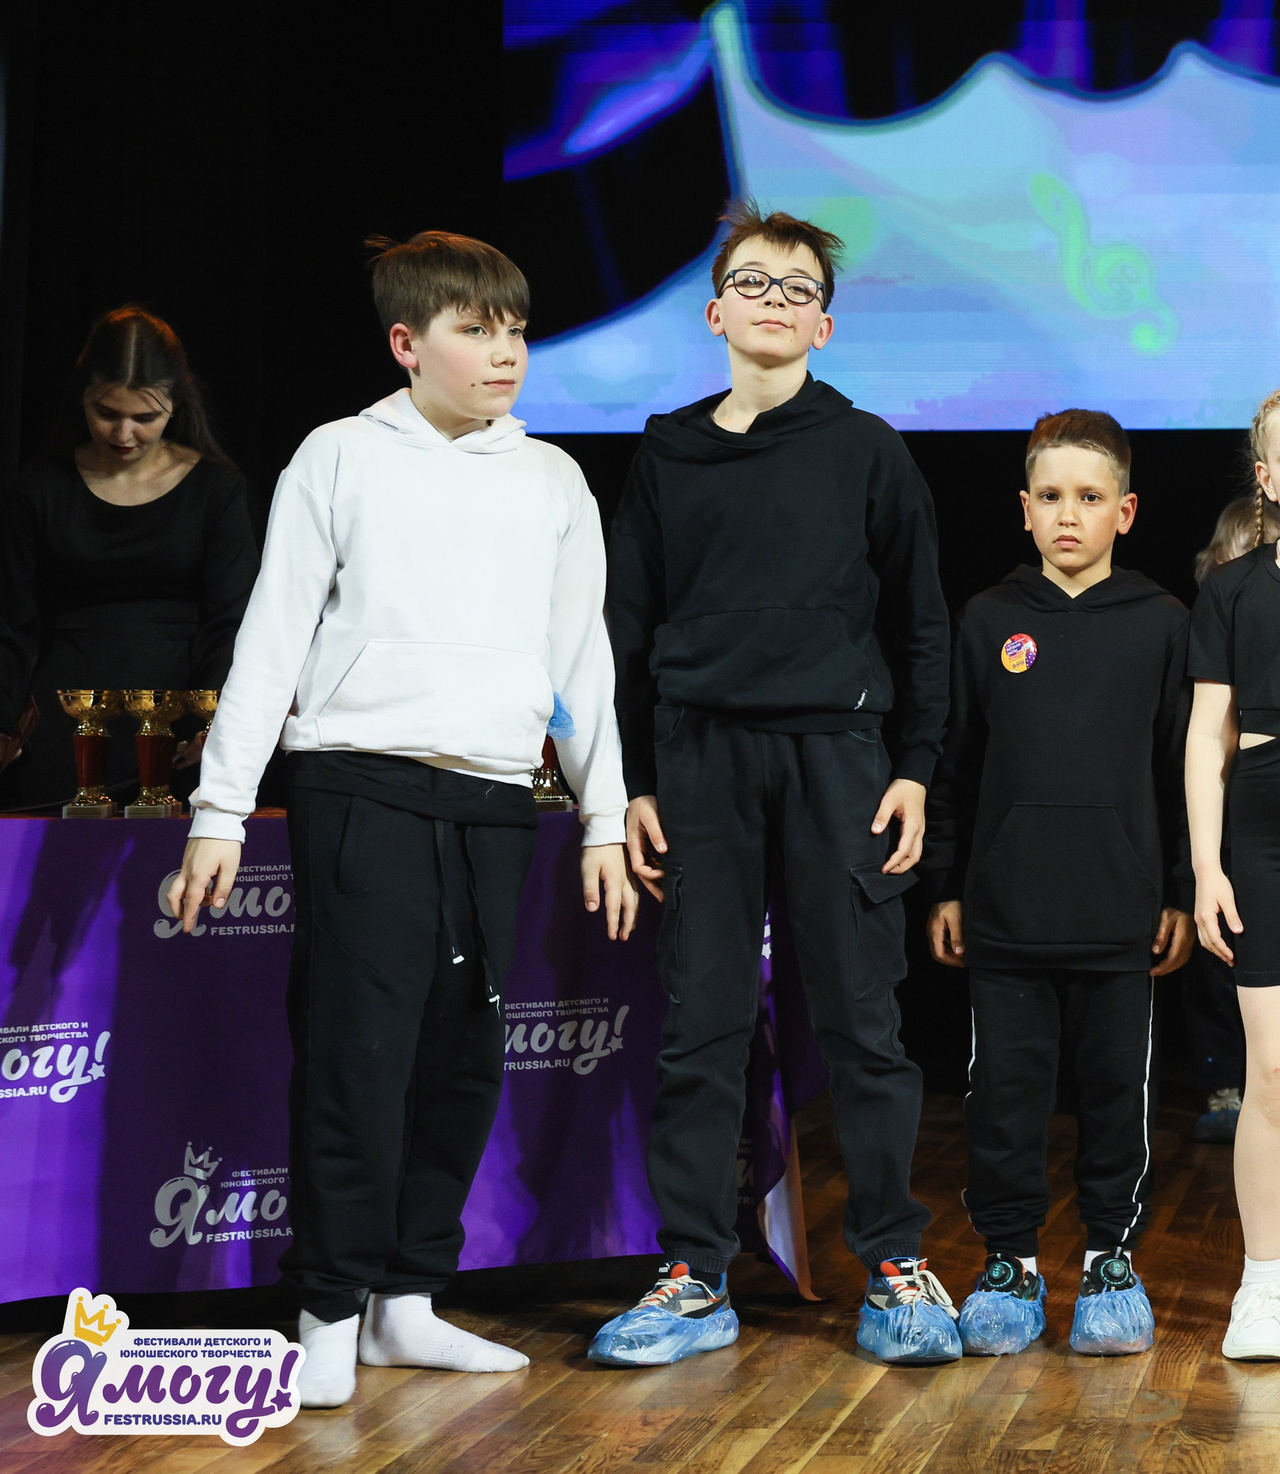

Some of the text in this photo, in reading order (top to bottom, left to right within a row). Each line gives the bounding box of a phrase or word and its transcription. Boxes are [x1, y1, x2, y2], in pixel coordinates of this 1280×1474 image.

[557, 998, 600, 1008] ДЕТСКОГО
[555, 1006, 609, 1016] ТВОРЧЕСТВА
[31, 1022, 79, 1033] ДЕТСКОГО
[29, 1031, 89, 1042] ТВОРЧЕСТВА
[232, 1167, 288, 1178] ФЕСТИВАЛИ
[220, 1177, 285, 1189] ЮНОШЕСКОГО
[150, 1176, 211, 1248] Я
[206, 1227, 294, 1243] FESTRUSSIA.R
